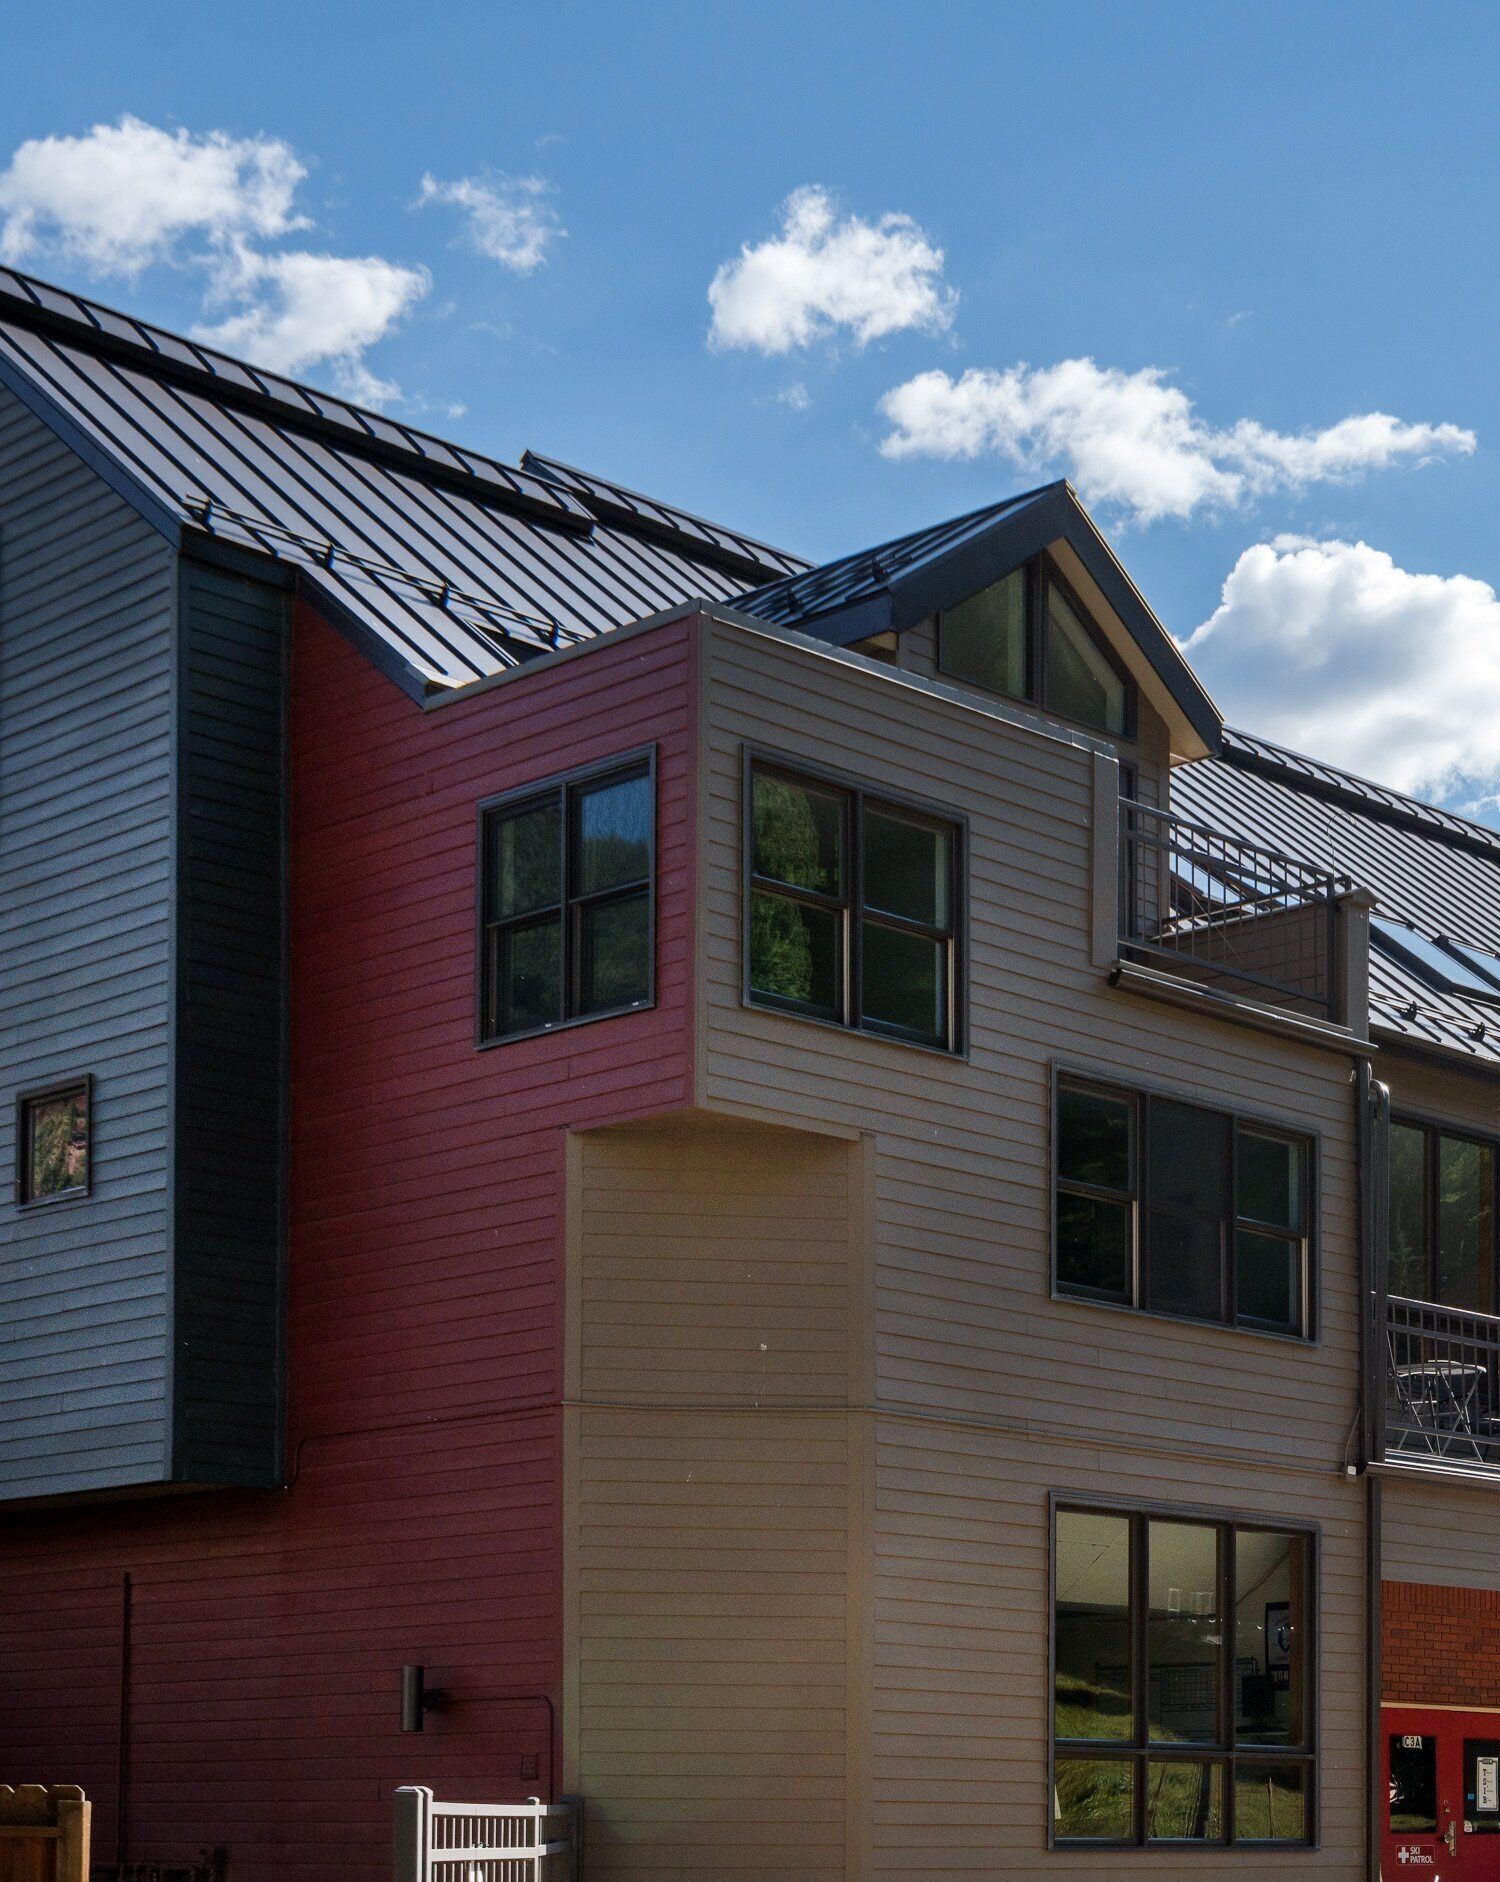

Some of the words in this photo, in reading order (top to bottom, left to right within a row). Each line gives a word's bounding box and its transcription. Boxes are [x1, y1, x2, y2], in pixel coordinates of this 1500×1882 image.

[1404, 1736, 1420, 1747] C3A
[1410, 1846, 1420, 1855] SKI
[1410, 1856, 1434, 1864] PATROL
